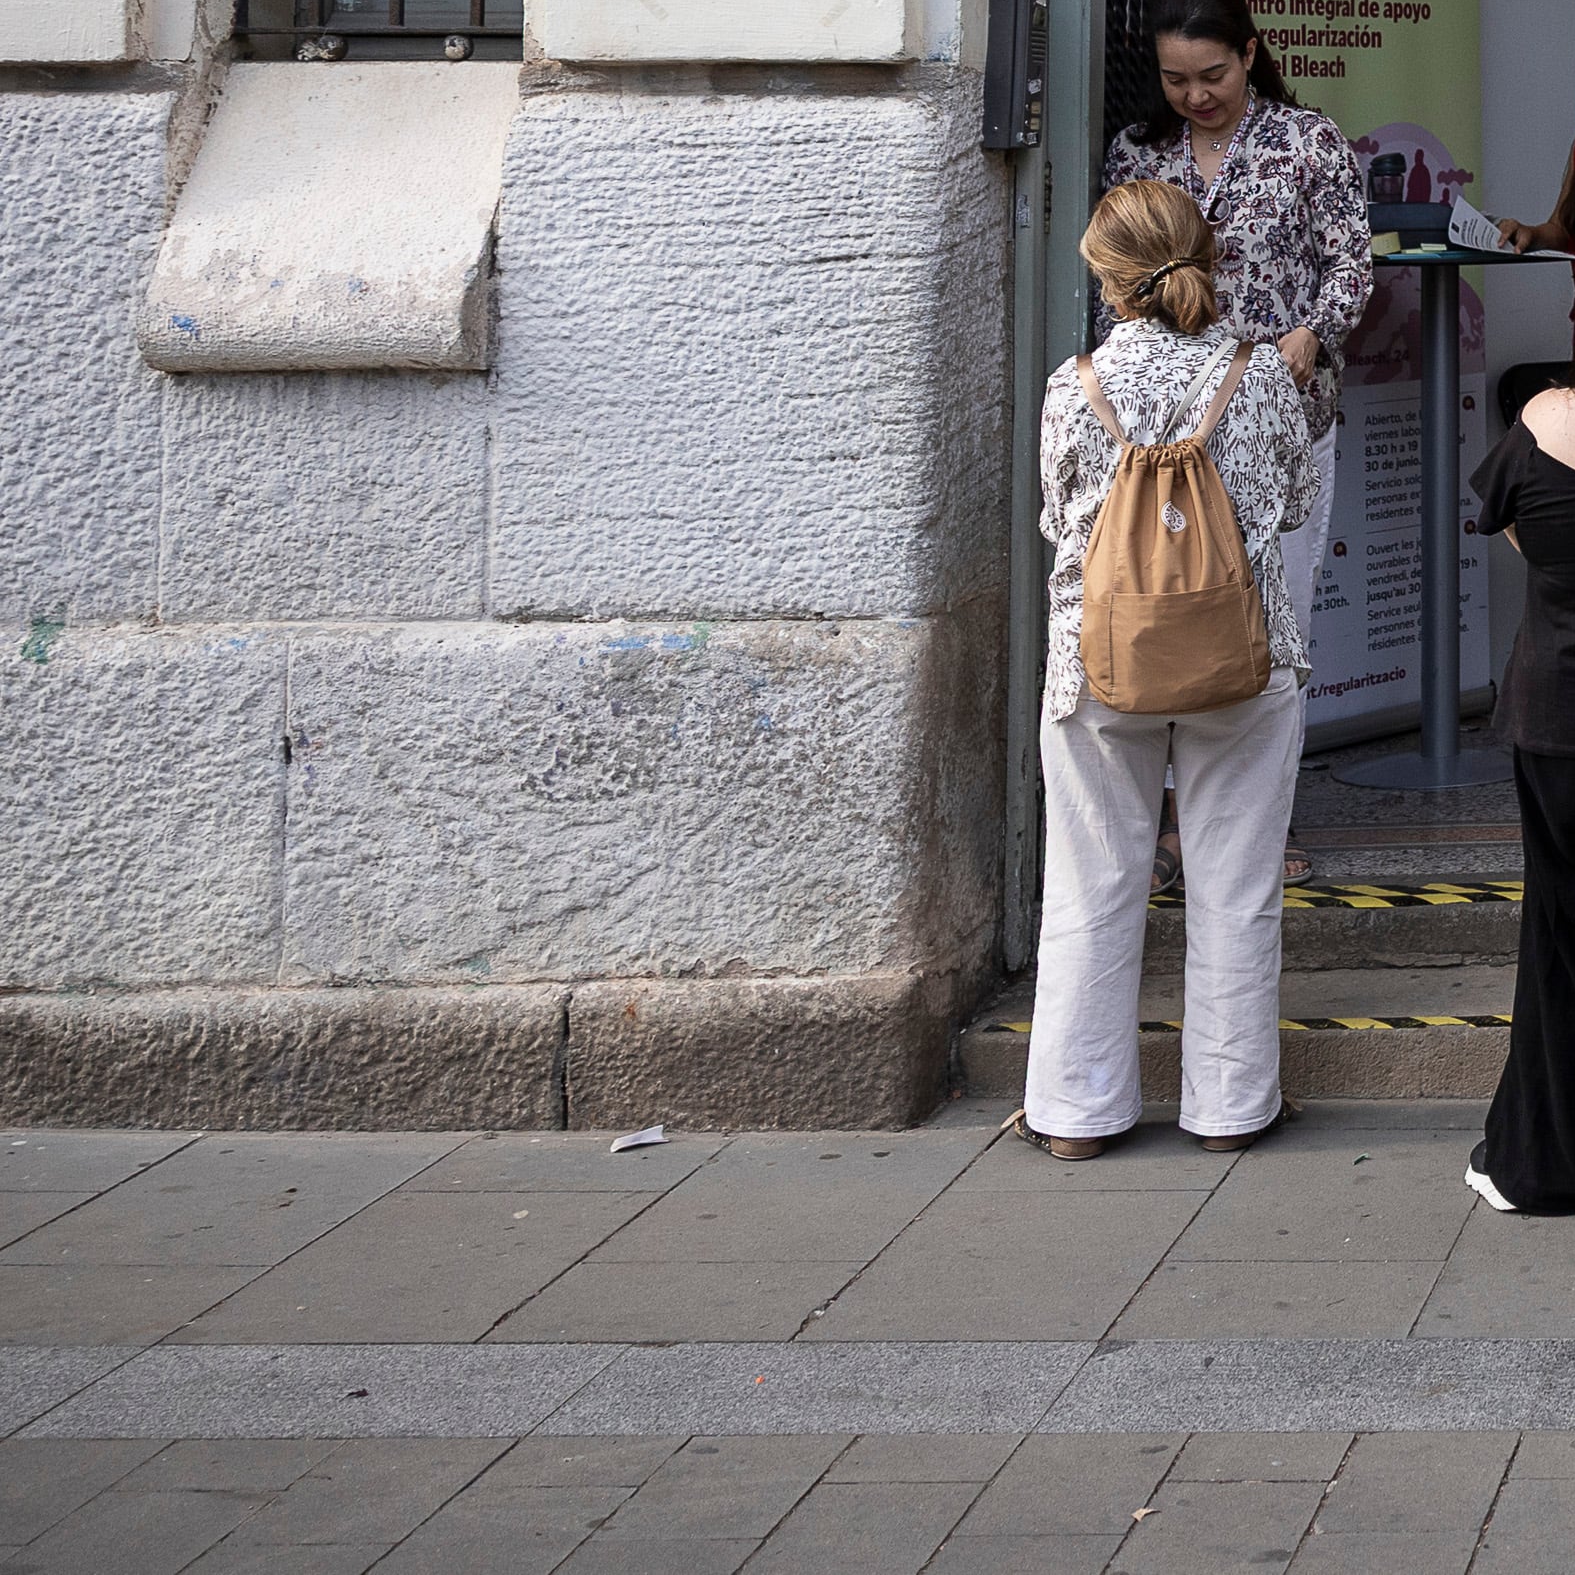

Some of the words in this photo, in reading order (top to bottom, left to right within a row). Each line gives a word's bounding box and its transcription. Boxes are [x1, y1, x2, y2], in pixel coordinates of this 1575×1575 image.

[1383, 1, 1431, 24] apoyo
[1260, 23, 1382, 51] regularización
[1291, 54, 1346, 78] Bleach
[1365, 412, 1403, 426] Abierto,
[1405, 411, 1417, 422] de
[1364, 430, 1399, 442] viernes
[1364, 444, 1388, 457] 8.30
[1390, 442, 1397, 454] h
[1399, 444, 1405, 453] a
[1408, 439, 1418, 452] 19
[1364, 460, 1379, 473] 30
[1382, 458, 1394, 470] de
[1395, 455, 1422, 472] junio.
[1364, 476, 1402, 492] Servicio
[1365, 492, 1408, 509] personas
[1365, 505, 1415, 522] residentes
[1366, 542, 1400, 556] Ouvert
[1401, 539, 1415, 550] les
[1366, 556, 1411, 571] ouvrables
[1366, 569, 1409, 586] vendredi,
[1324, 584, 1339, 595] am
[1366, 586, 1406, 605] jusqu'au
[1408, 582, 1421, 594] 30
[1323, 596, 1350, 610] 30th.
[1367, 606, 1401, 621] Service
[1367, 618, 1415, 639] personnes
[1367, 634, 1416, 652] résidentes
